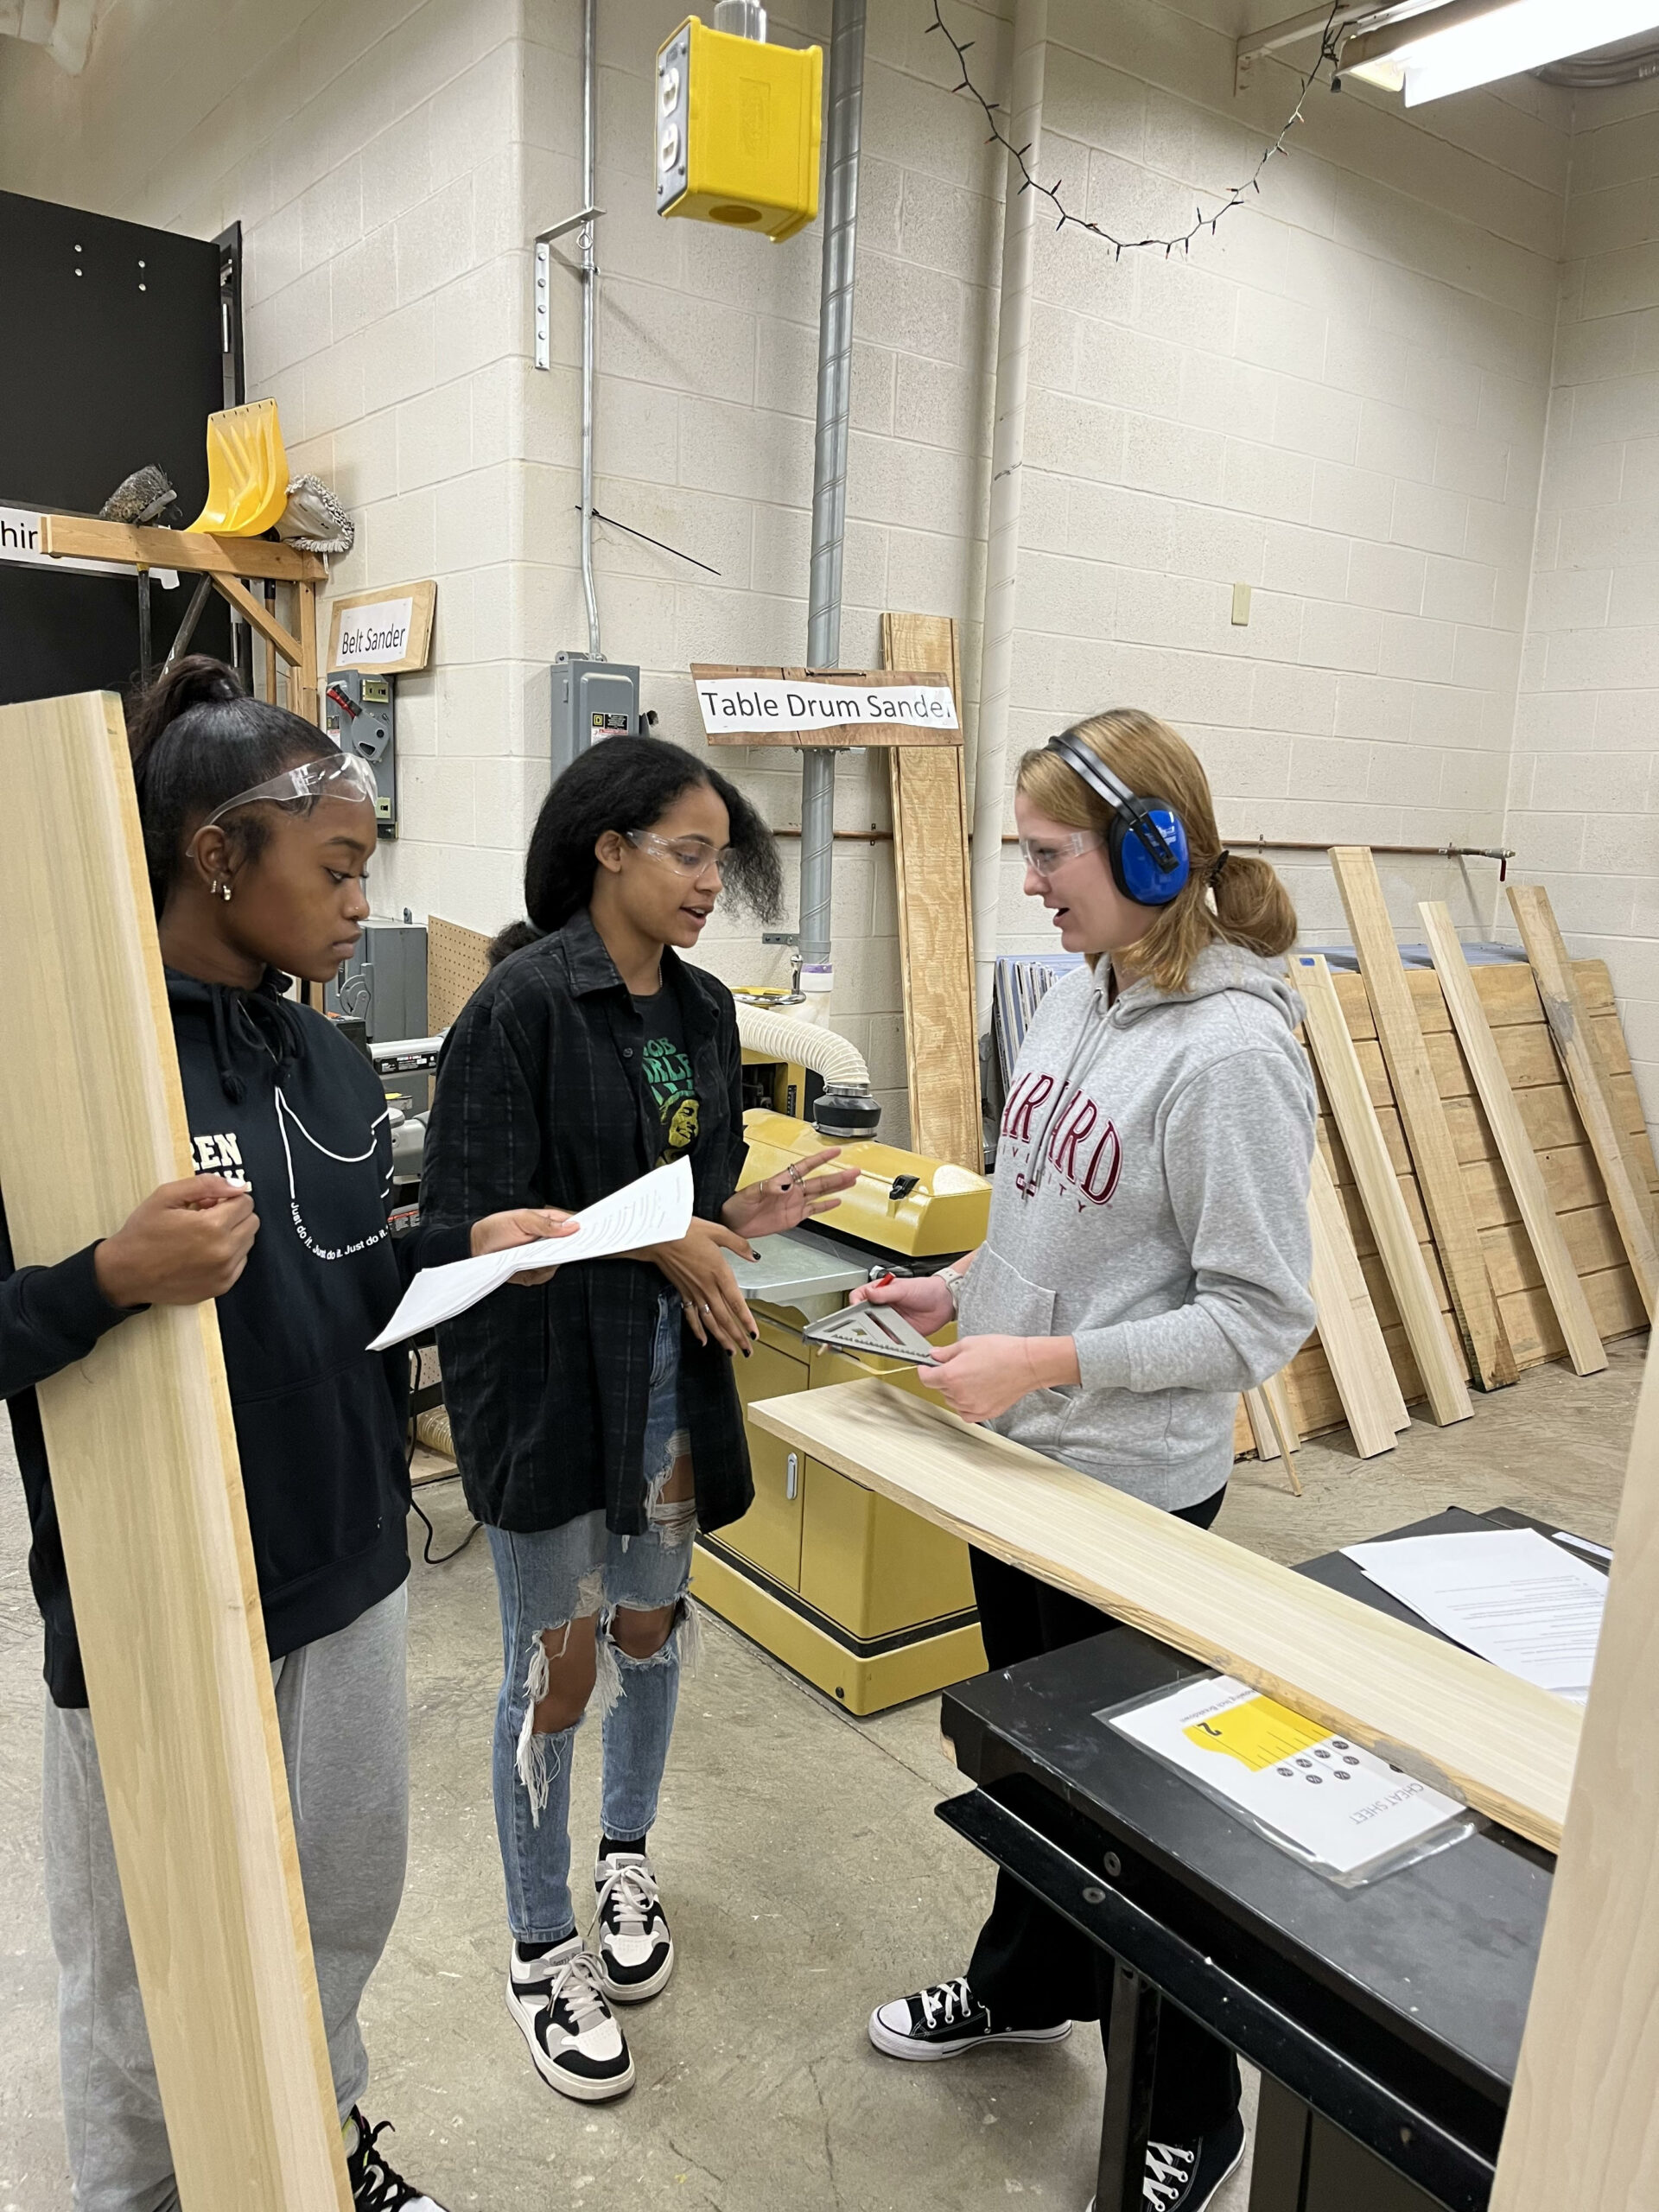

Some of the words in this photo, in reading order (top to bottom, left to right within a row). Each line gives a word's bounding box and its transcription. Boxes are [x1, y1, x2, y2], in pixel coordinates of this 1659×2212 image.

[341, 628, 364, 655] Belt
[365, 623, 406, 652] Sander
[701, 690, 779, 718] Table
[788, 692, 861, 719] Drum
[642, 1038, 676, 1057] OB
[290, 1202, 302, 1225] Just
[296, 1225, 308, 1239] do
[304, 1236, 313, 1249] it.
[312, 1244, 327, 1259] Just
[327, 1250, 336, 1260] do
[344, 1241, 365, 1255] Just
[365, 1236, 379, 1246] do
[1196, 1722, 1223, 1737] 2
[1382, 1782, 1425, 1807] CHEAT
[1348, 1800, 1389, 1825] SHEET
